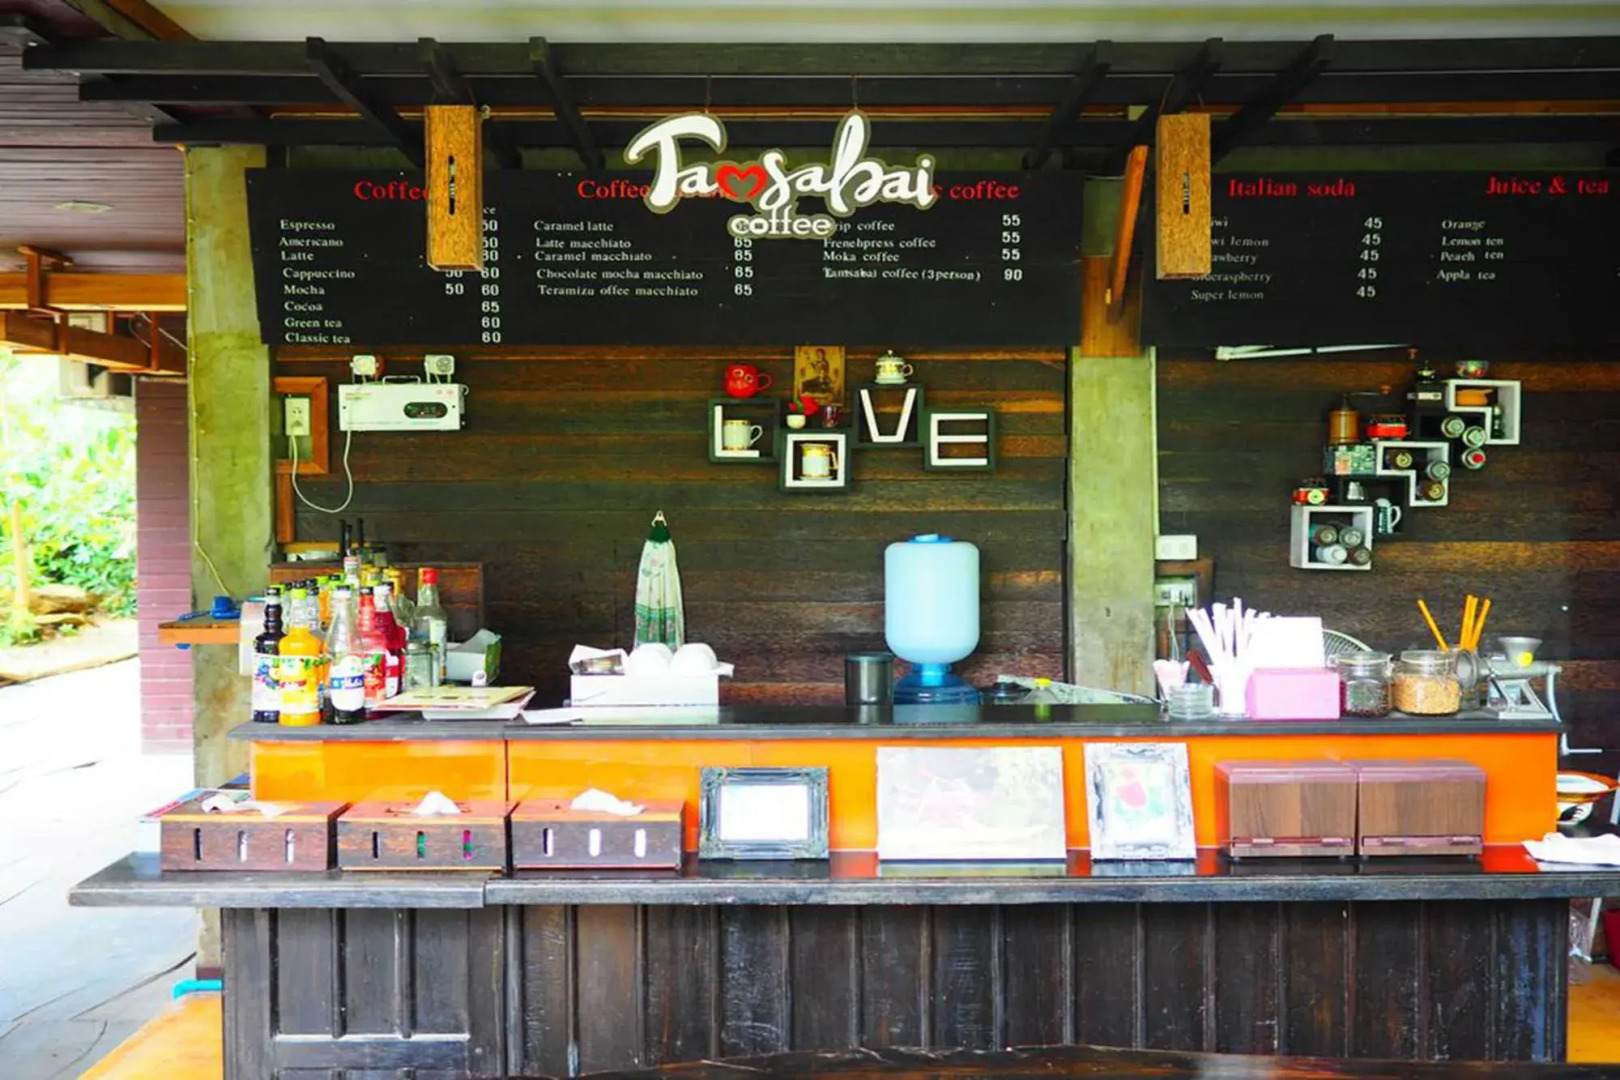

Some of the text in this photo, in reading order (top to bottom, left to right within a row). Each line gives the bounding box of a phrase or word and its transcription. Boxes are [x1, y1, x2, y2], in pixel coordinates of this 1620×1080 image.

[949, 180, 1021, 199] coffee
[1229, 179, 1356, 197] Italian soda
[1485, 176, 1609, 194] Juice & tea
[731, 201, 832, 235] coffee
[1002, 214, 1021, 227] 55
[1364, 217, 1382, 229] 45
[280, 219, 335, 231] Espresso
[534, 220, 614, 232] Caramel latte
[857, 220, 895, 231] coffee
[1442, 220, 1485, 231] Orange
[279, 237, 343, 247] Americano
[536, 237, 631, 248] Latte macchiato
[734, 238, 752, 248] 65
[899, 237, 936, 248] coffee
[1002, 231, 1020, 244] 55
[1230, 235, 1270, 246] lemon
[1362, 234, 1381, 246] 45
[1442, 236, 1481, 246] Lemon
[281, 250, 314, 261] Latte
[535, 250, 652, 261] Caramel macchiato
[734, 250, 752, 262] 65
[823, 251, 900, 262] Moka coffee
[1002, 249, 1020, 260] 55
[1360, 249, 1379, 262] 45
[1440, 251, 1475, 261] Peach
[283, 268, 355, 280] Cappuccino
[481, 267, 499, 278] 60
[537, 268, 703, 280] Chocolate mocha macchiato
[734, 266, 753, 278] 65
[882, 268, 918, 278] coffee
[921, 268, 981, 281] (3person)
[1004, 268, 1022, 281] 90
[1357, 267, 1377, 280] 45
[1478, 271, 1496, 280] tea
[284, 284, 325, 295] Mocha
[445, 283, 464, 295] 50
[481, 284, 499, 296] 60
[600, 284, 629, 296] offee
[635, 284, 698, 296] macchiato
[734, 284, 752, 296] 65
[1191, 289, 1264, 301] Super lemon
[1357, 286, 1376, 298] 45
[284, 301, 323, 311] Cocoa
[481, 301, 500, 313] 65
[284, 317, 342, 328] Green tea
[481, 316, 500, 329] 60
[285, 332, 351, 344] Classic tea
[481, 331, 501, 344] 60
